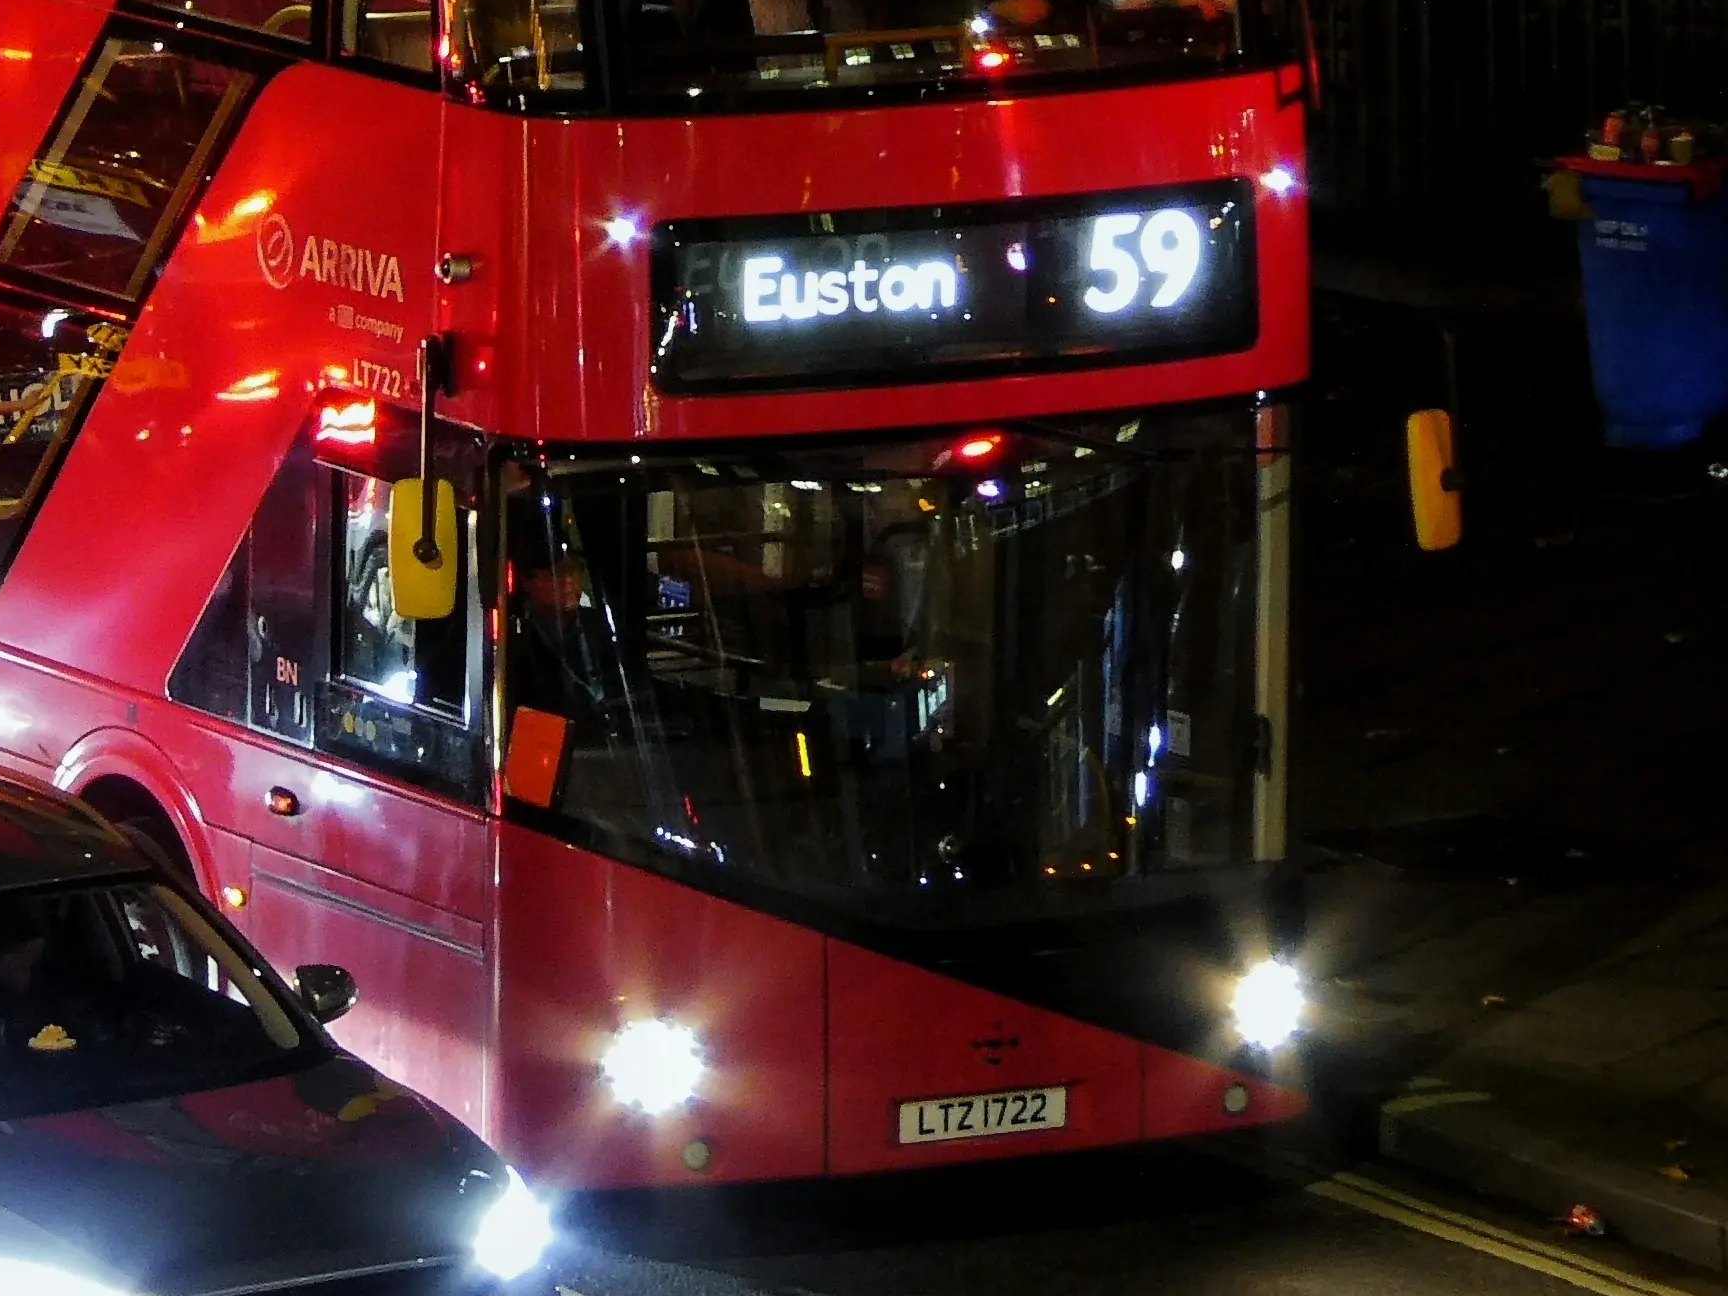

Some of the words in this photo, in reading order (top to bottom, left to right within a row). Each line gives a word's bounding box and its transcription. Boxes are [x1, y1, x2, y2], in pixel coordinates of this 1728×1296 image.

[300, 235, 404, 303] ARRIVA
[1083, 208, 1201, 314] 59
[743, 255, 957, 323] Euston
[355, 314, 404, 344] company
[353, 358, 401, 398] LT722
[276, 656, 299, 686] BN
